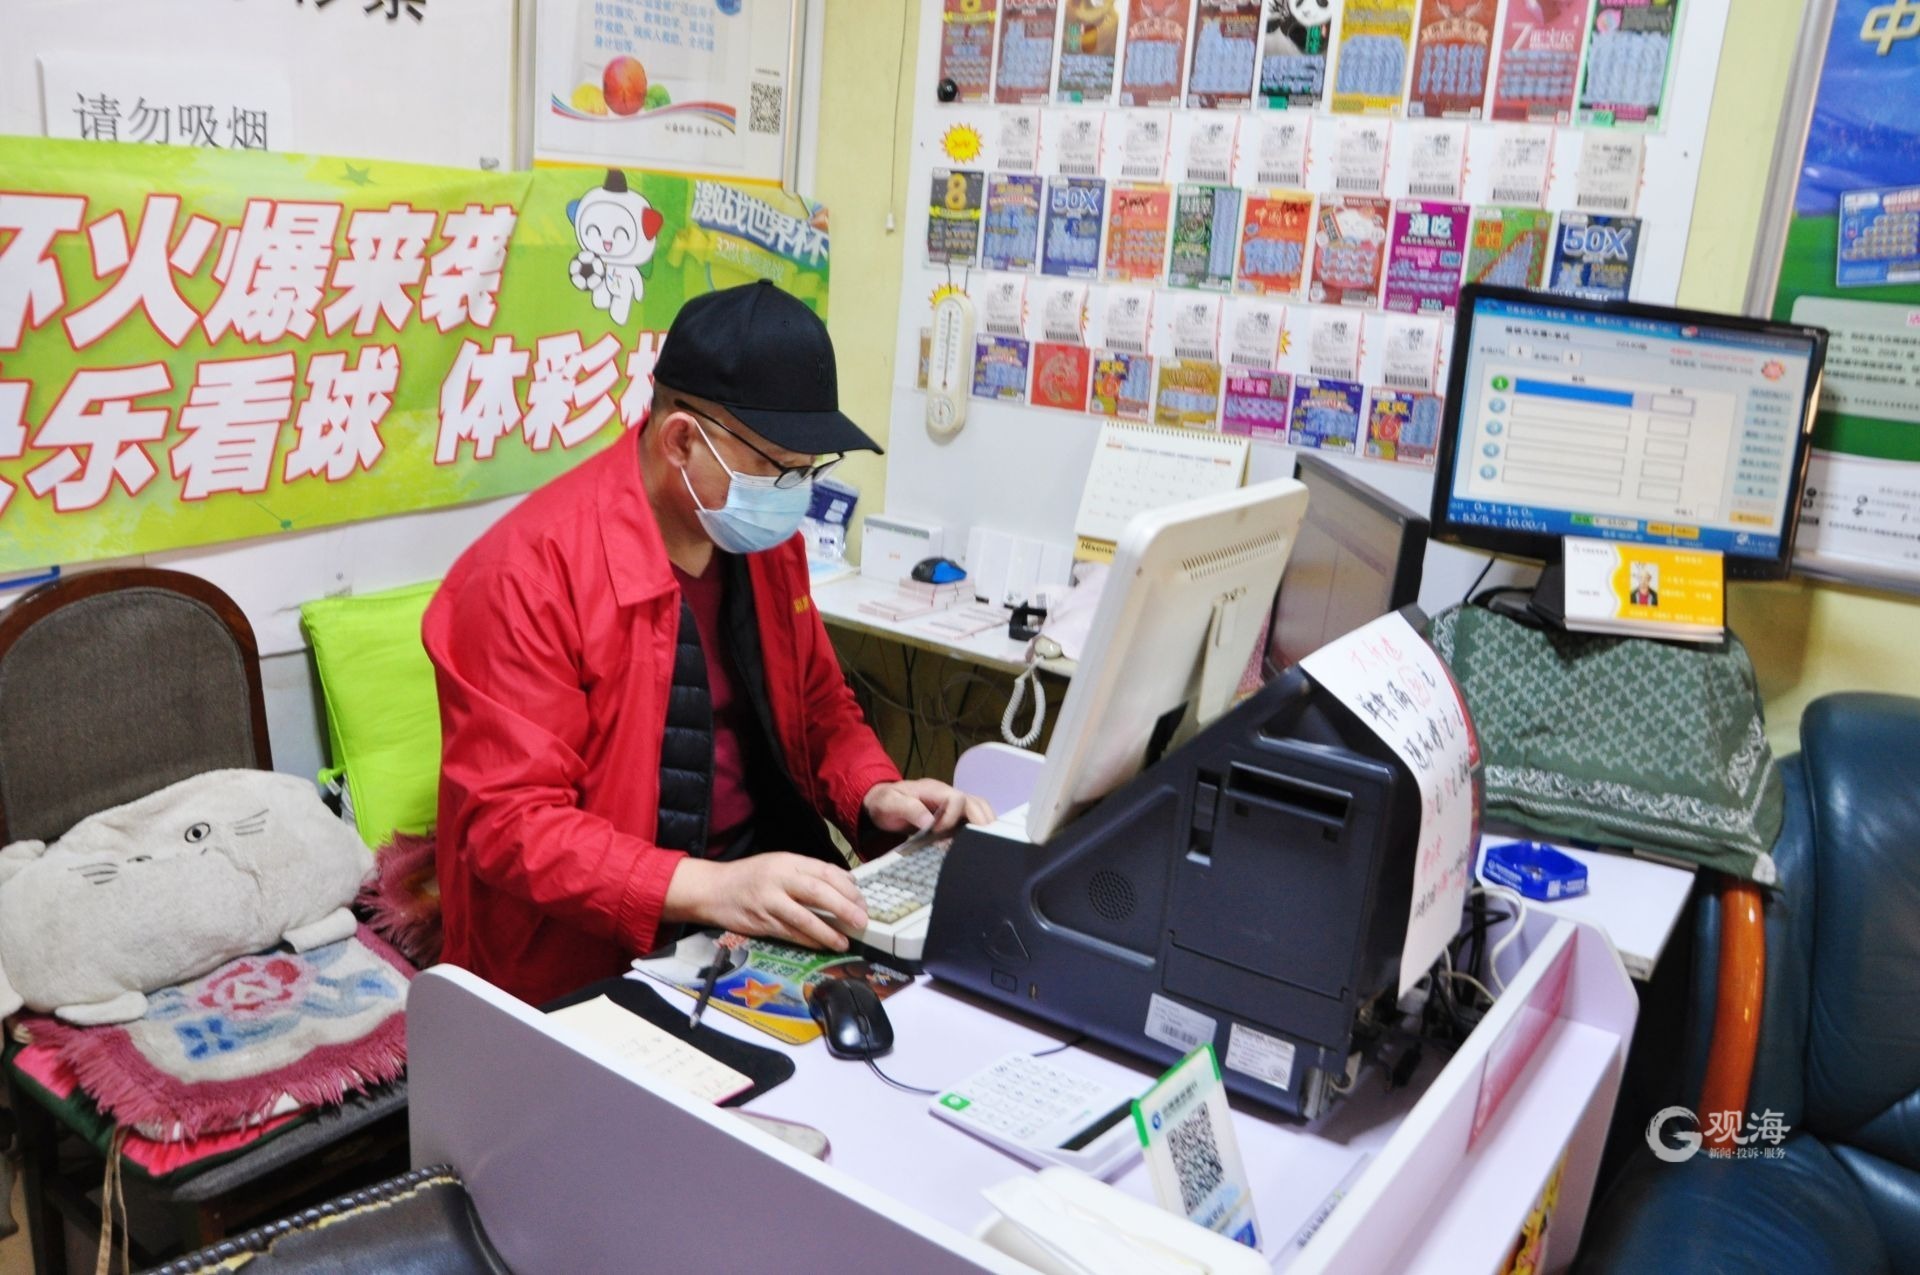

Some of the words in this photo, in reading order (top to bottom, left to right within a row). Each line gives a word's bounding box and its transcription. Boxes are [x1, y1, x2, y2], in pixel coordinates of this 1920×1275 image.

[72, 91, 269, 151] 请勿吸烟
[691, 179, 830, 268] 激战世界杯
[1051, 185, 1101, 216] 50X
[1563, 223, 1633, 260] 50X
